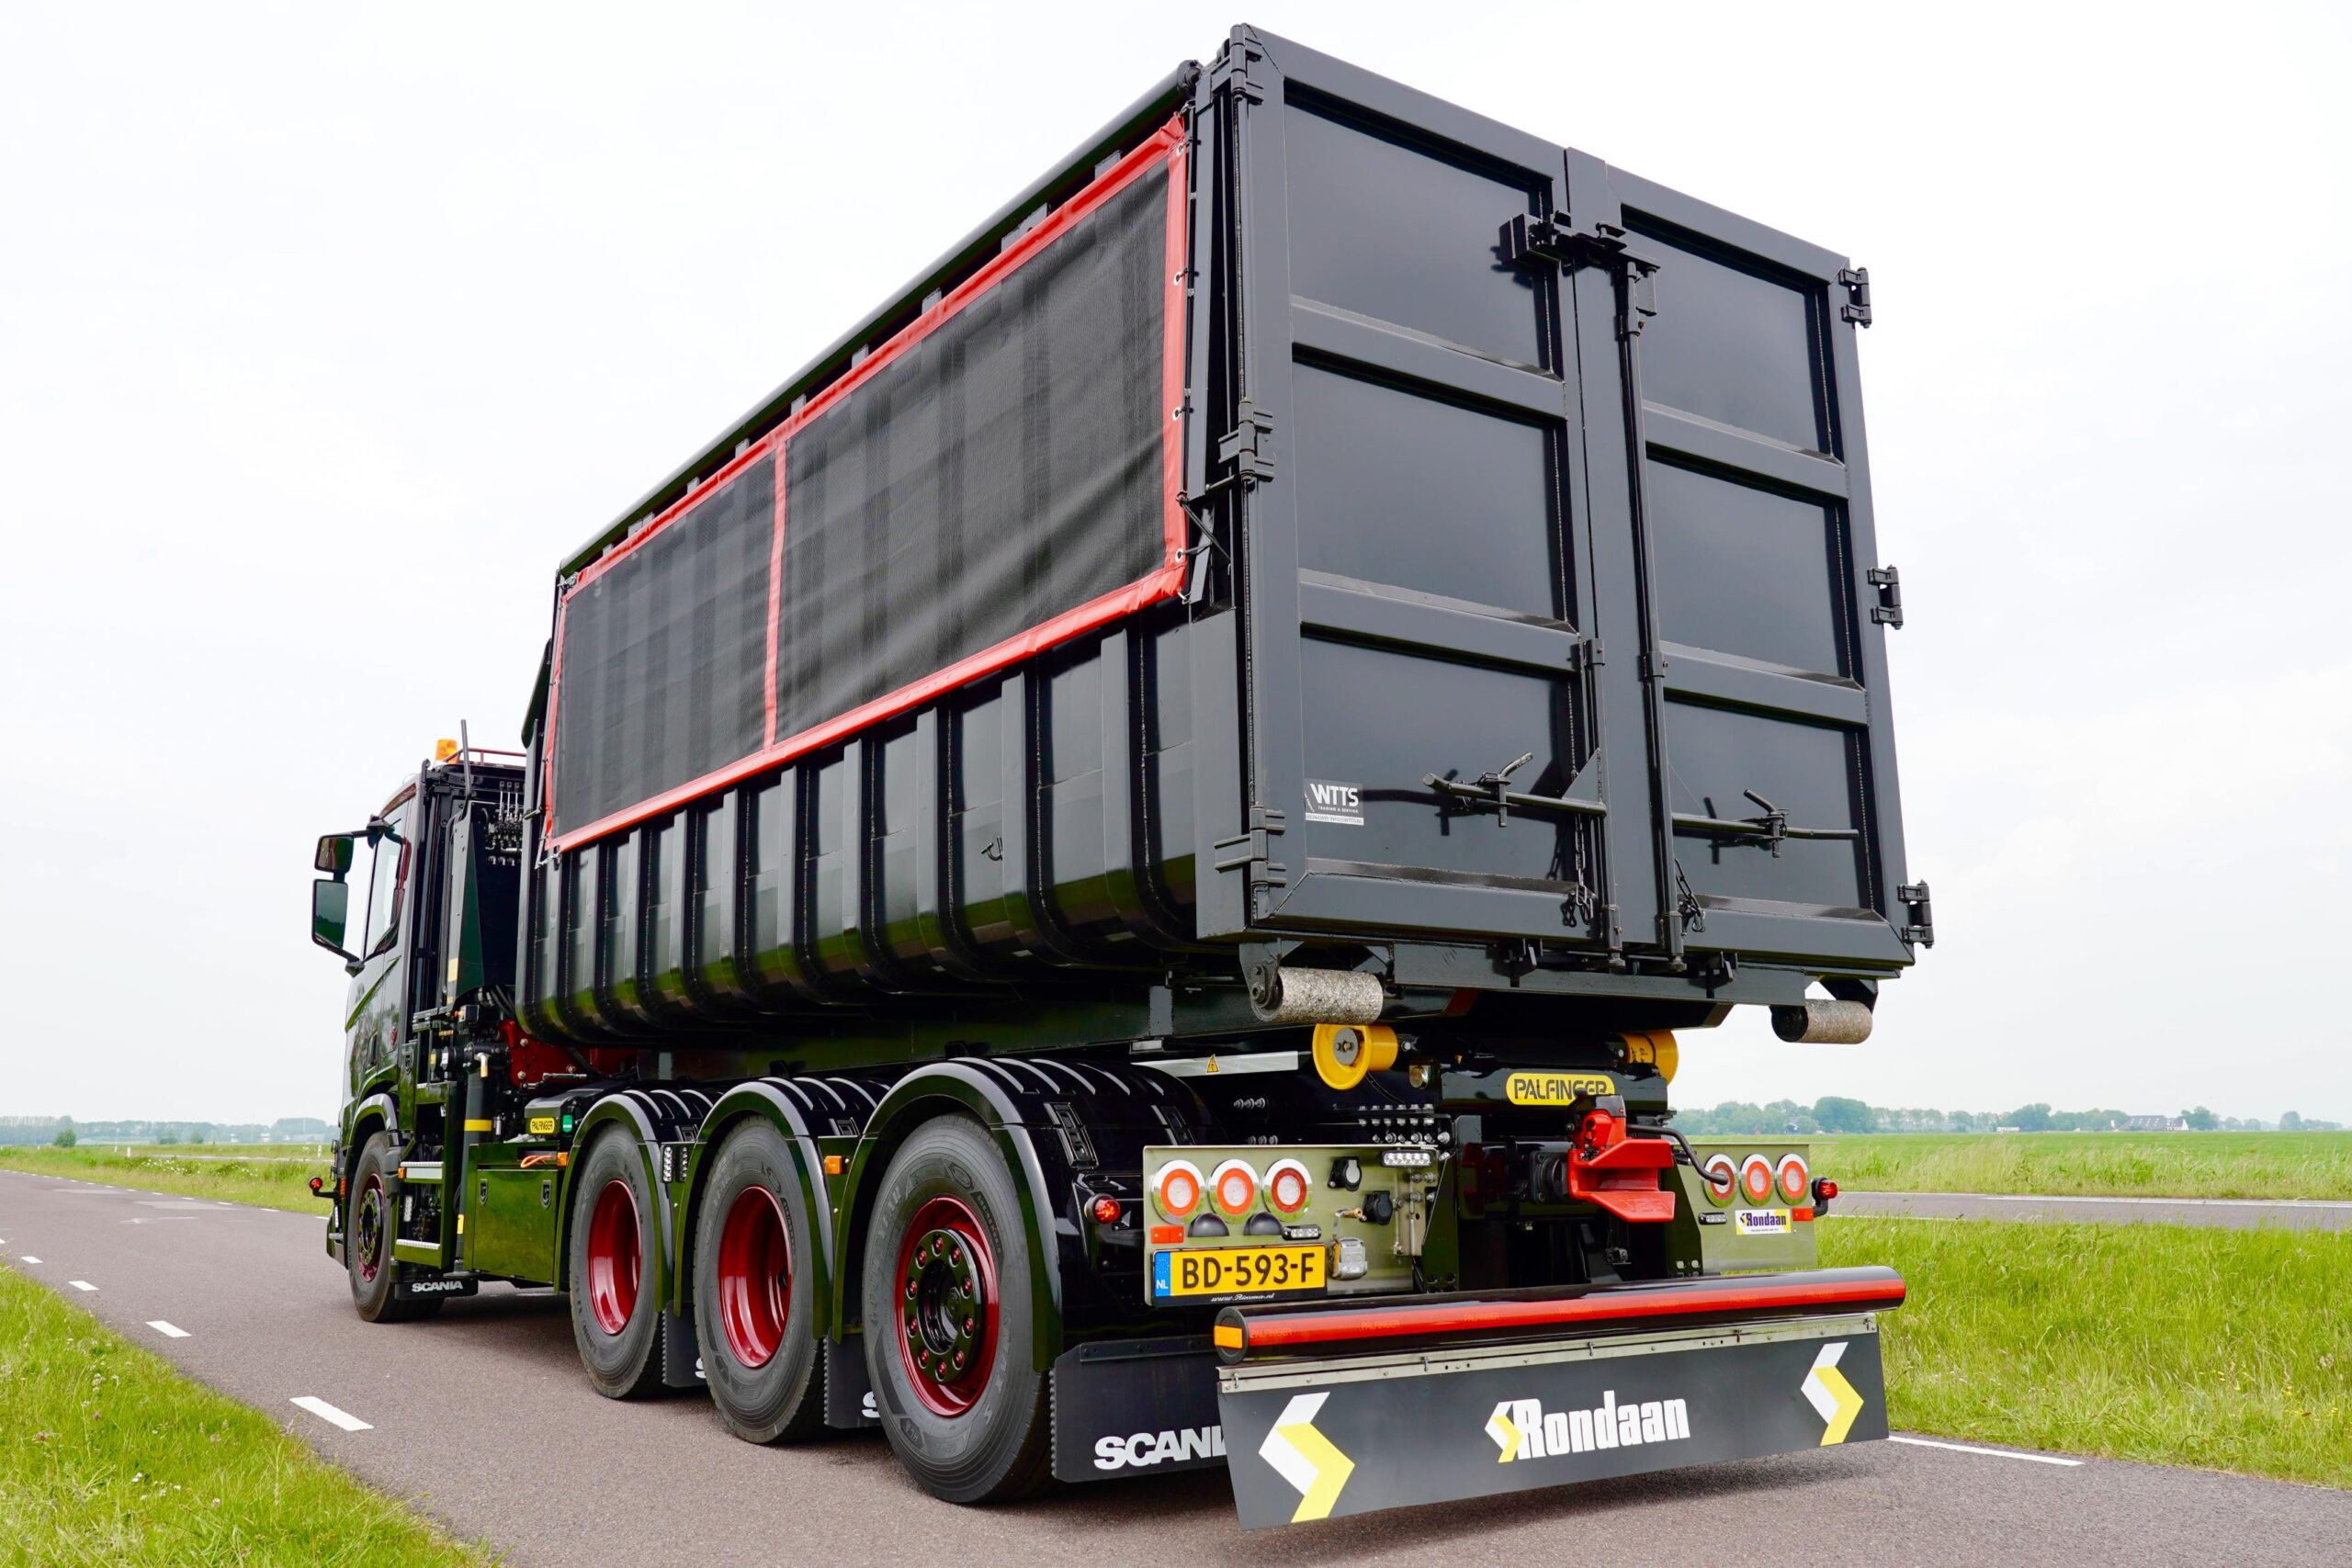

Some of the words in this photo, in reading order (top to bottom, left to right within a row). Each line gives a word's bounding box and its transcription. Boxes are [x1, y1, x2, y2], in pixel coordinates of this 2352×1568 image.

[1309, 783, 1359, 807] WTTS
[1513, 1078, 1608, 1100] PALFINGER
[531, 1120, 553, 1131] PALFINGER
[1746, 1212, 1787, 1226] Rondaan
[1156, 1279, 1170, 1290] NL
[1182, 1252, 1316, 1290] BD-593-F
[412, 1280, 464, 1292] SCANIA
[1511, 1390, 1691, 1461] Rondaan
[1093, 1425, 1227, 1471] SCANI
